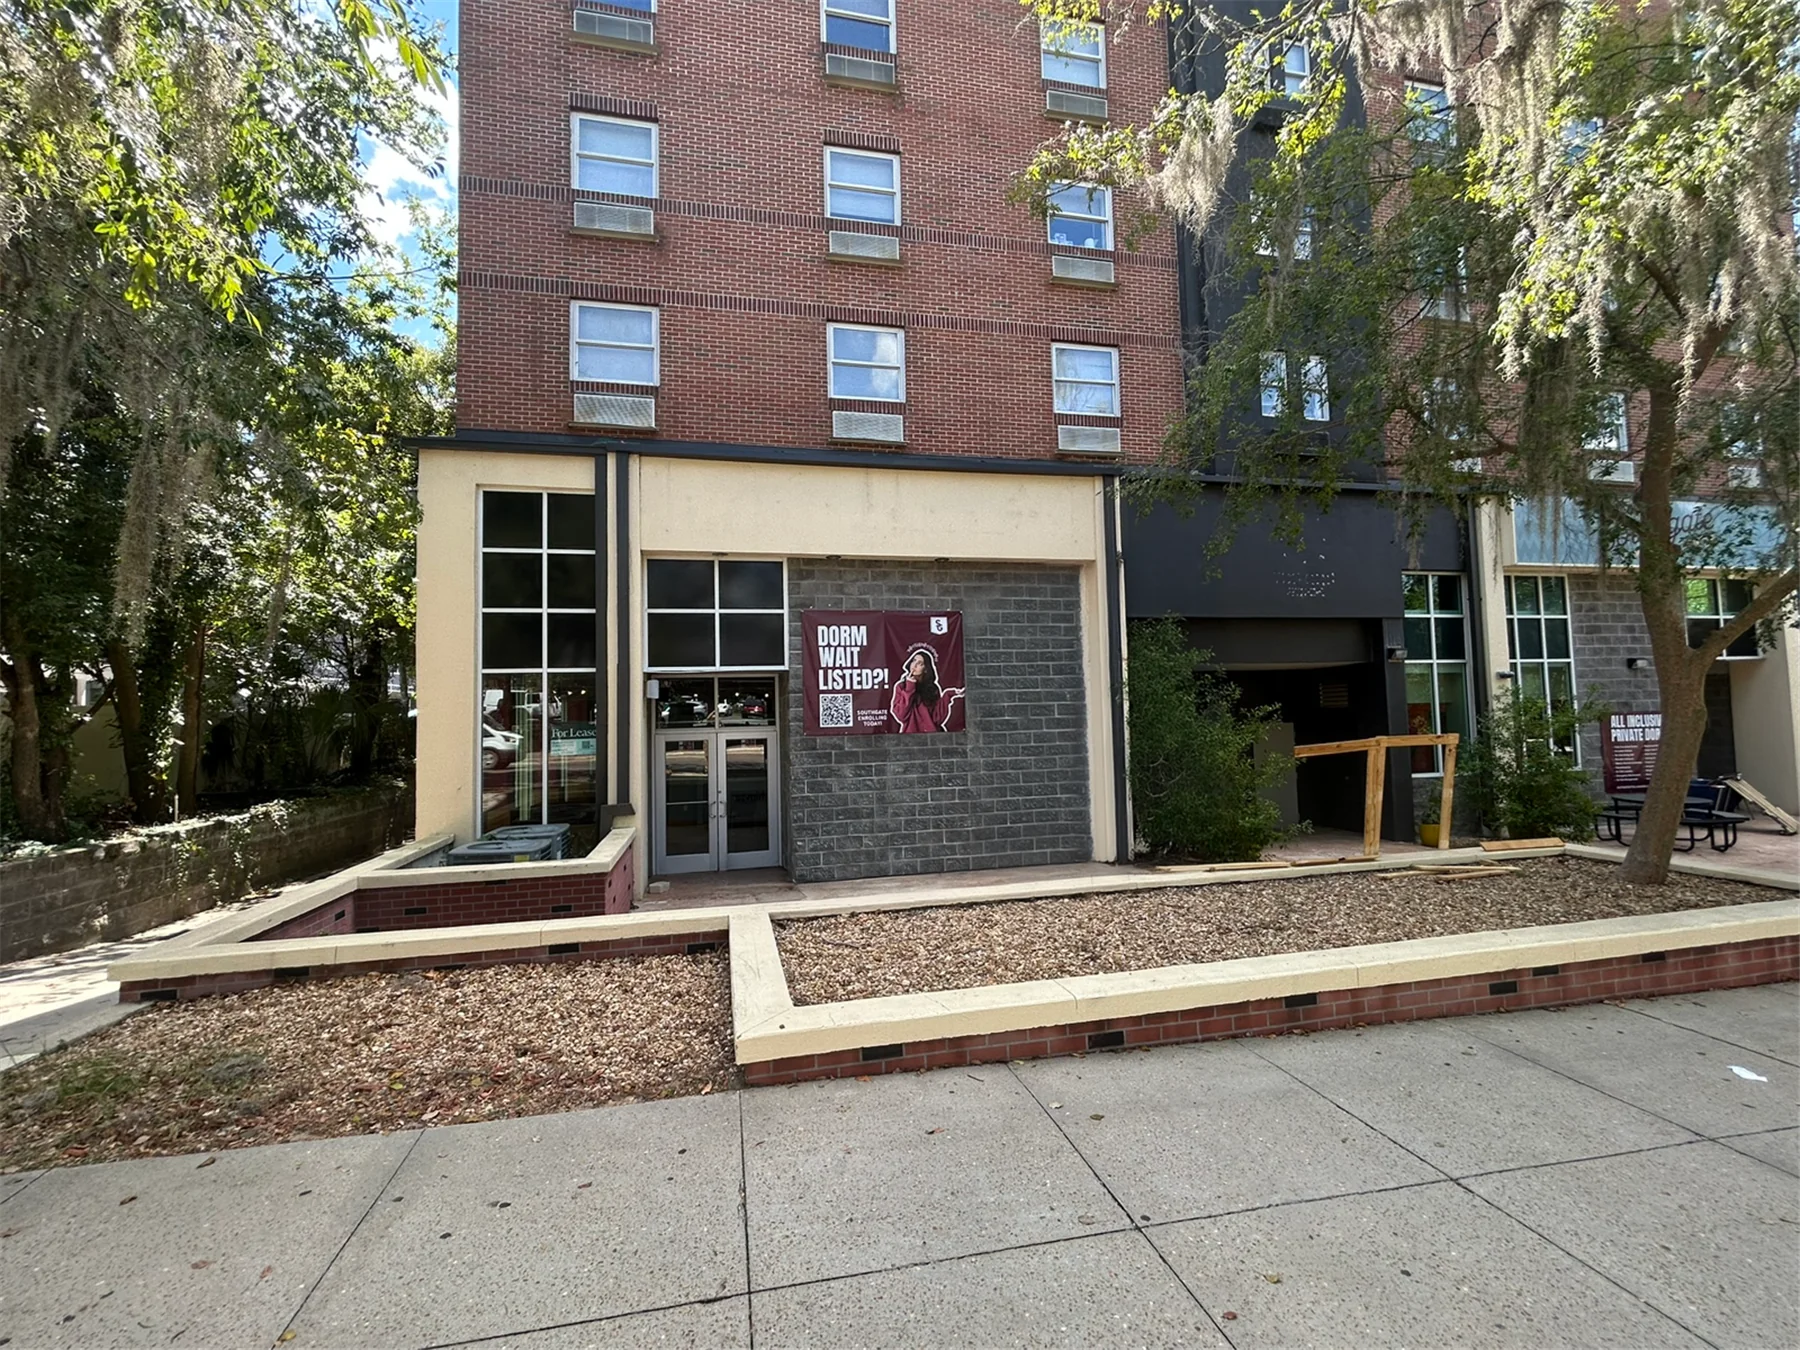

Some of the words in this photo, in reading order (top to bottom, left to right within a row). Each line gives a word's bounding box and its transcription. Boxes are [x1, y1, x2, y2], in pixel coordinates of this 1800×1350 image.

[817, 625, 867, 646] DORM
[818, 646, 861, 667] WAIT
[818, 668, 889, 690] LISTED?!
[1610, 714, 1626, 728] ALL
[1626, 713, 1662, 728] INCLUSIV
[552, 729, 569, 738] For
[570, 728, 597, 738] Lease
[1610, 728, 1643, 742] PRIVATE
[1644, 727, 1661, 741] DOR
